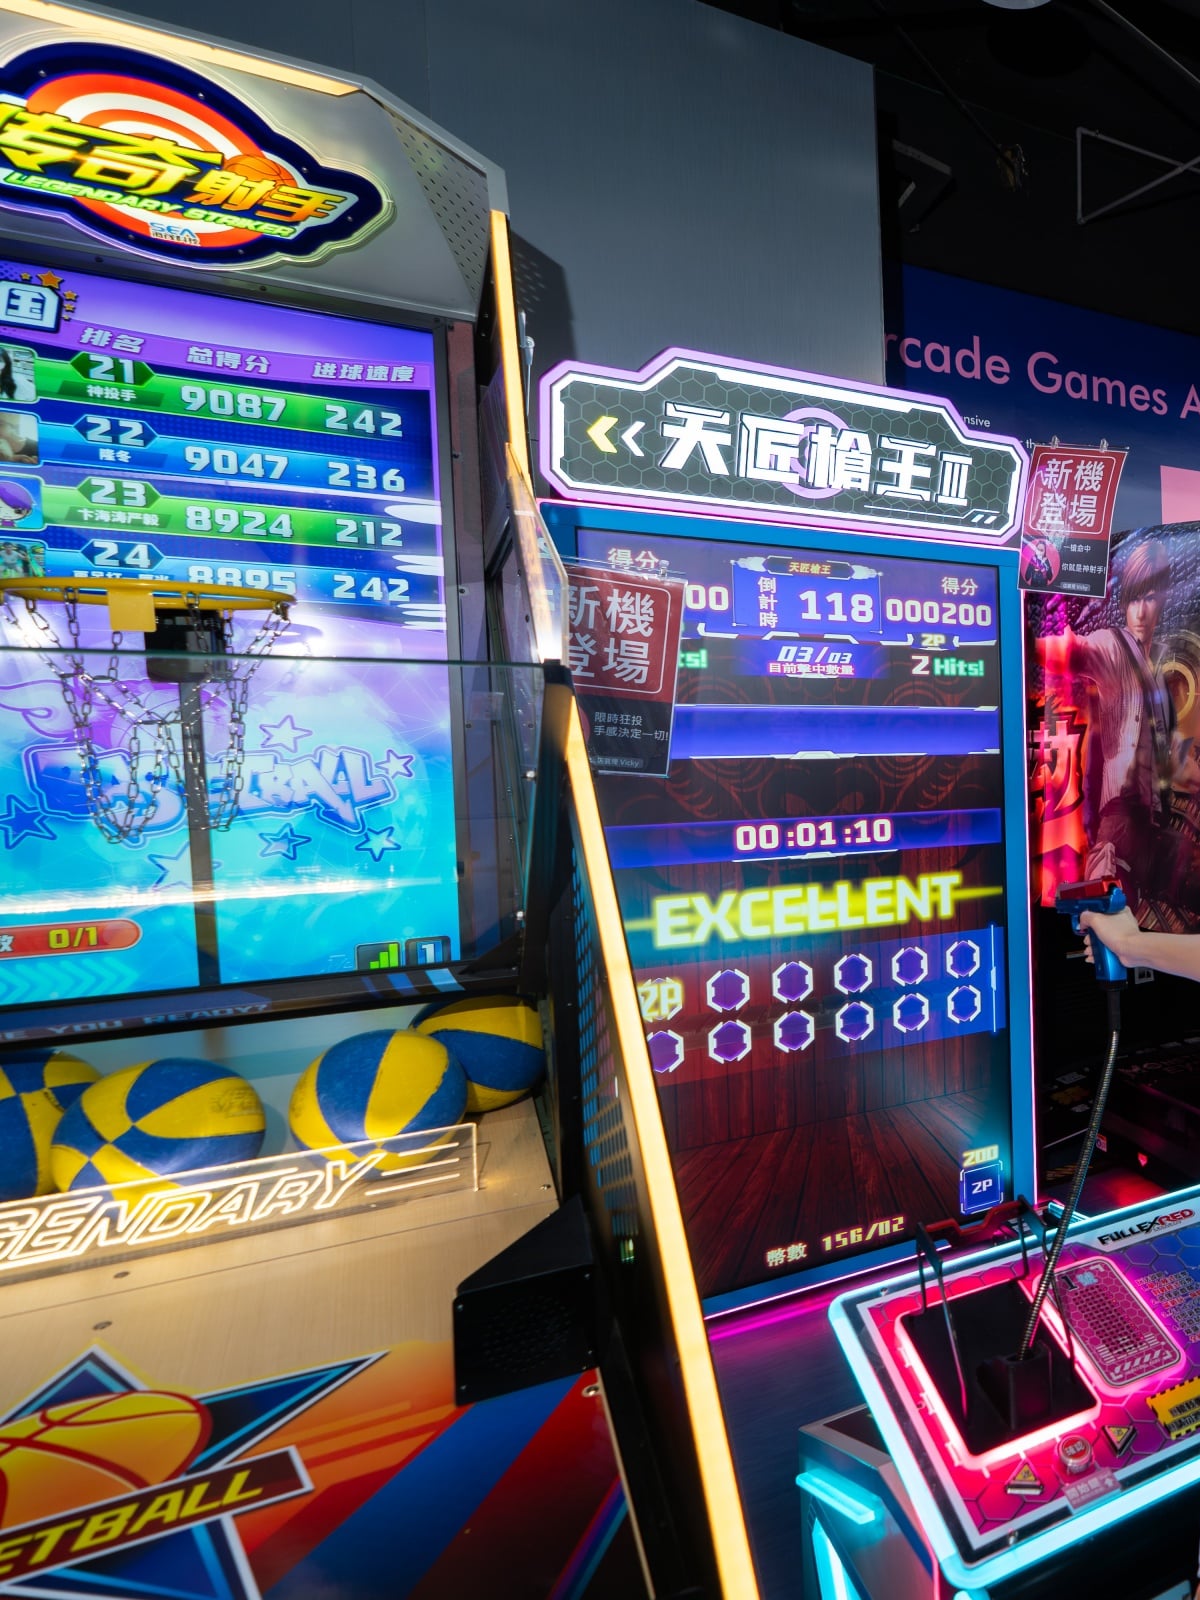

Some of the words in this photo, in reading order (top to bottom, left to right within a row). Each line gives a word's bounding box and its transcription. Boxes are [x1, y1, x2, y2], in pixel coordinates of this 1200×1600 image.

[4, 171, 183, 214] LEGENDARY
[183, 206, 298, 238] STRIKER
[149, 221, 197, 240] SEA
[79, 327, 145, 354] 排名
[186, 346, 270, 374] 总得分
[311, 361, 416, 383] 进球速度
[86, 384, 138, 402] 神投手
[88, 353, 136, 385] 21
[181, 385, 287, 422] 9087
[325, 404, 404, 438] 242
[1027, 351, 1169, 417] Games
[85, 415, 145, 448] 22
[184, 445, 289, 480] 9047
[328, 461, 406, 492] 236
[1043, 458, 1104, 493] 新機
[90, 478, 147, 507] 23
[186, 505, 294, 538] 8924
[335, 518, 404, 547] 212
[1039, 492, 1097, 528] 登場
[92, 540, 152, 569] 24
[187, 565, 297, 595] 8895
[333, 574, 410, 602] 242
[607, 547, 660, 571] 得分
[788, 561, 832, 576] 天匠槍王
[757, 576, 779, 629] 倒計時
[941, 576, 980, 597] 得分
[799, 590, 875, 624] 118
[885, 598, 993, 627] 000200
[776, 645, 853, 664] 03/03
[920, 633, 947, 648] 2P
[933, 657, 985, 677] Hits!
[594, 711, 643, 727] 限時狂投
[654, 873, 963, 948] EXCELLENT
[48, 926, 98, 950] 0/1
[47, 1019, 124, 1034] YOU
[143, 1003, 268, 1026] READY?
[971, 1178, 993, 1195] 2P
[0, 1470, 263, 1577] ETBALL
